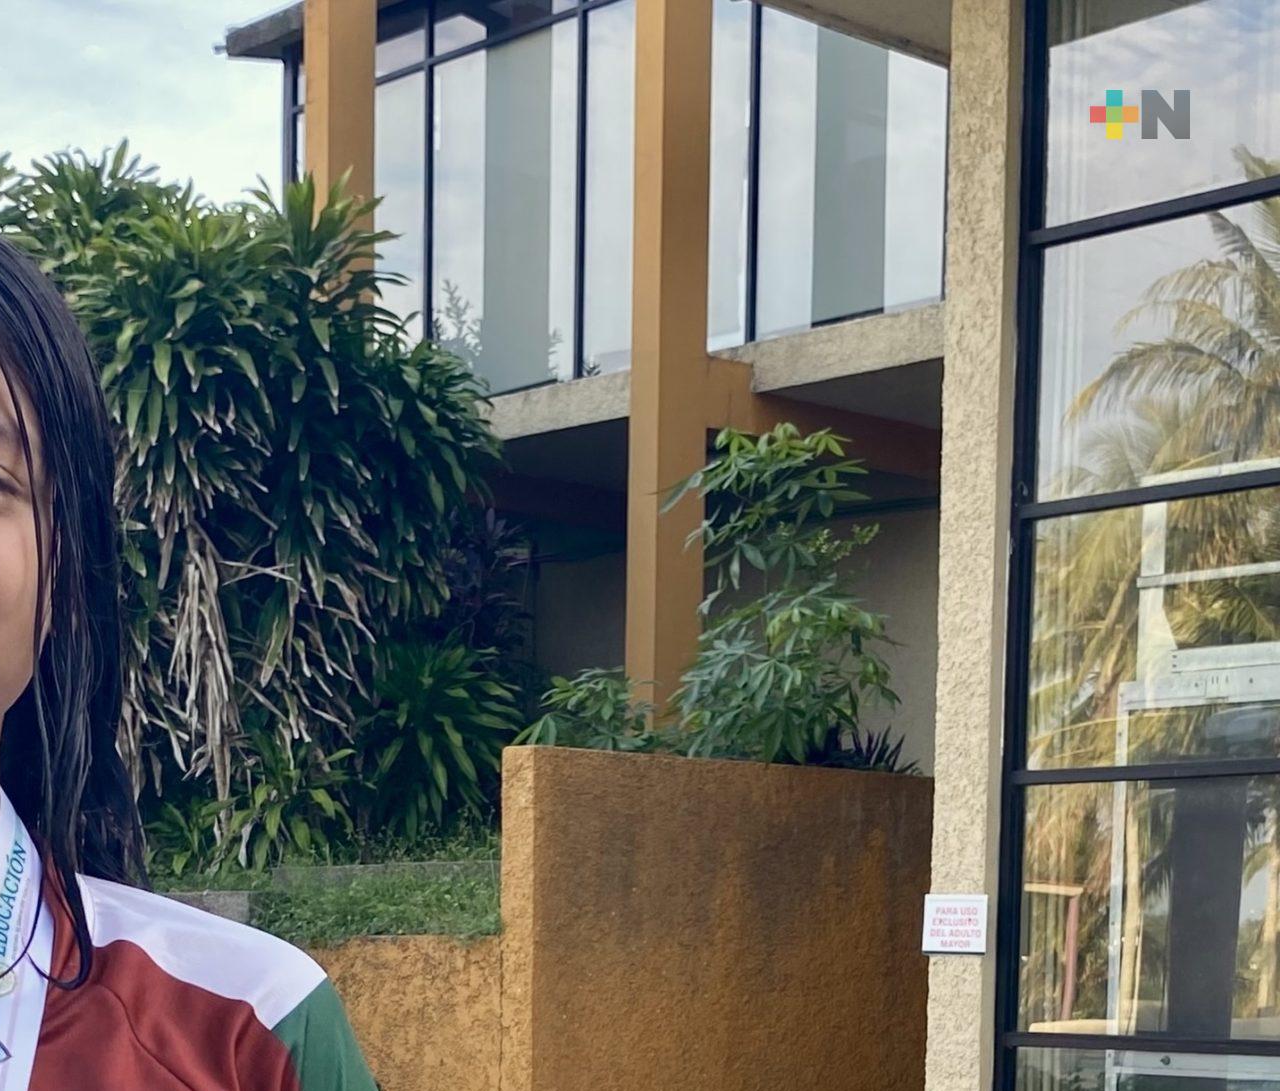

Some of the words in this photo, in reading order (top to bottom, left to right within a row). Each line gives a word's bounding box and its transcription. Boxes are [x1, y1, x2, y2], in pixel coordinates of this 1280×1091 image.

[935, 907, 958, 915] PARA
[960, 907, 978, 915] USO
[929, 928, 947, 937] DEL
[948, 928, 982, 938] ADULTO
[939, 940, 971, 948] MAYOR
